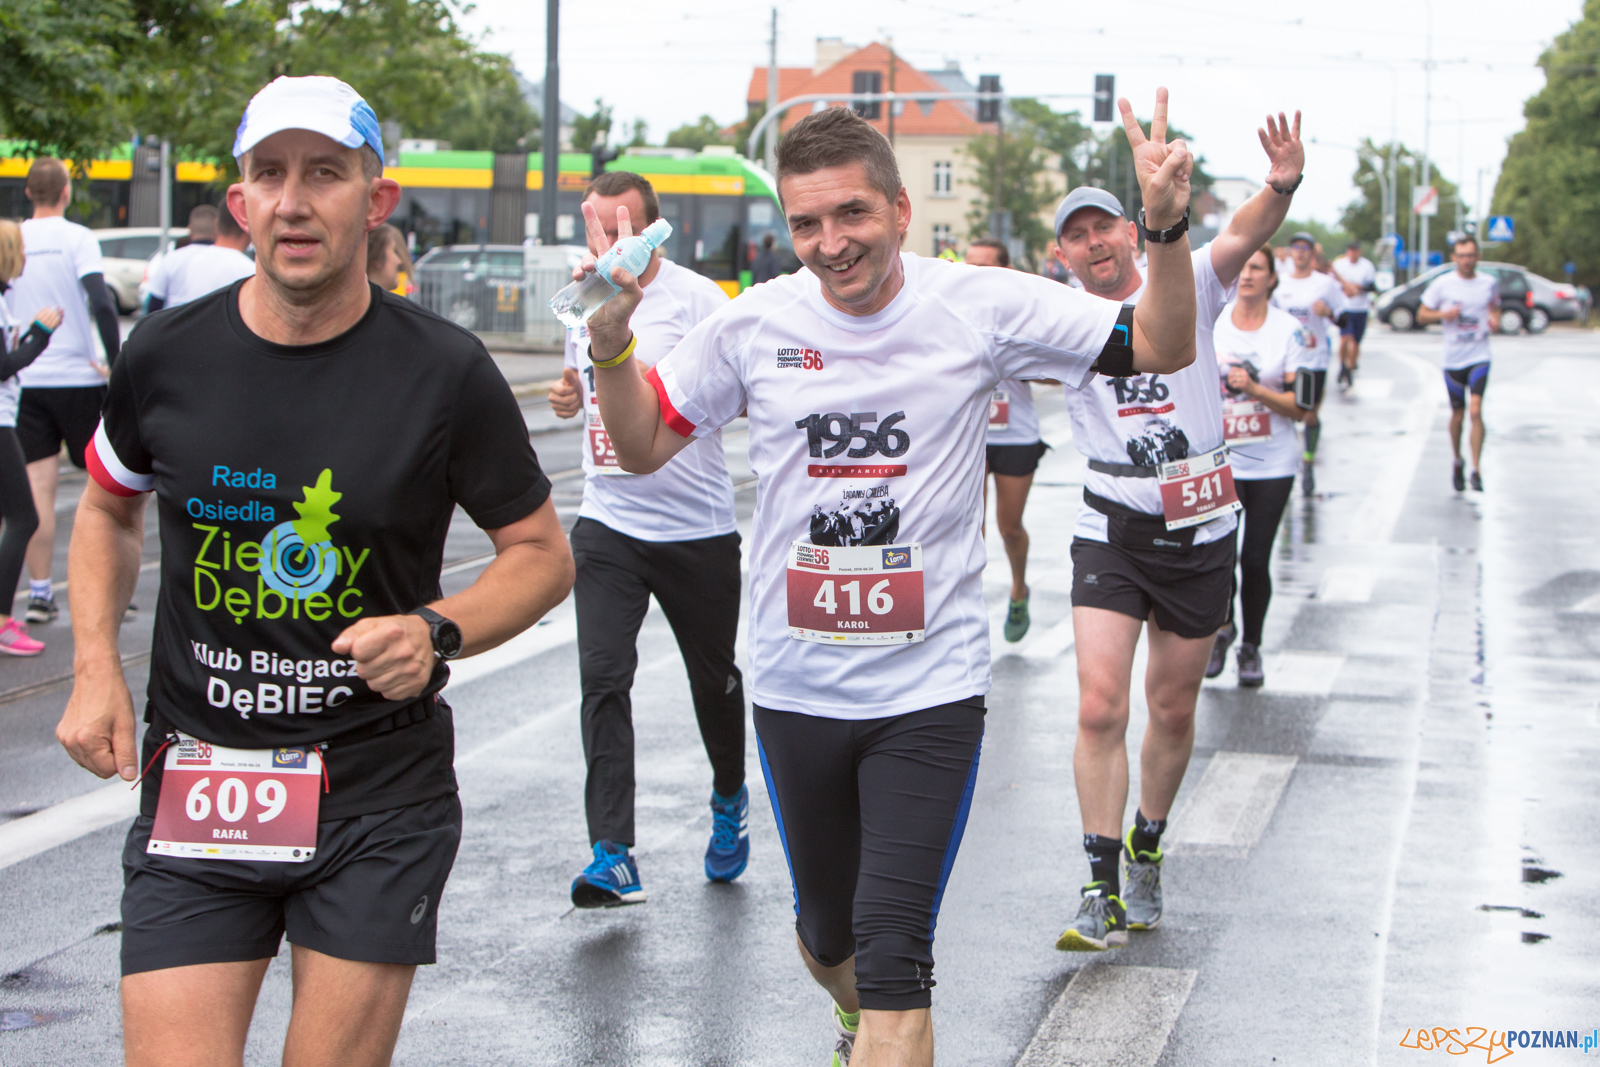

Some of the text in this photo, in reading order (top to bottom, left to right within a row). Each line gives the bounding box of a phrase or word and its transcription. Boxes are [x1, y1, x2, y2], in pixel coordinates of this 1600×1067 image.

[777, 348, 800, 356] LOTTO
[795, 410, 911, 459] 1956
[1225, 415, 1261, 434] 766
[212, 465, 277, 489] Rada
[1182, 472, 1223, 507] 541
[186, 497, 276, 522] Osiedla
[194, 566, 364, 625] Dębiec
[813, 578, 894, 615] 416
[837, 620, 870, 629] KAROL
[190, 639, 243, 672] Klub
[207, 676, 354, 720] DęBIEC
[185, 776, 288, 824] 609
[212, 828, 249, 840] RAFAŁ
